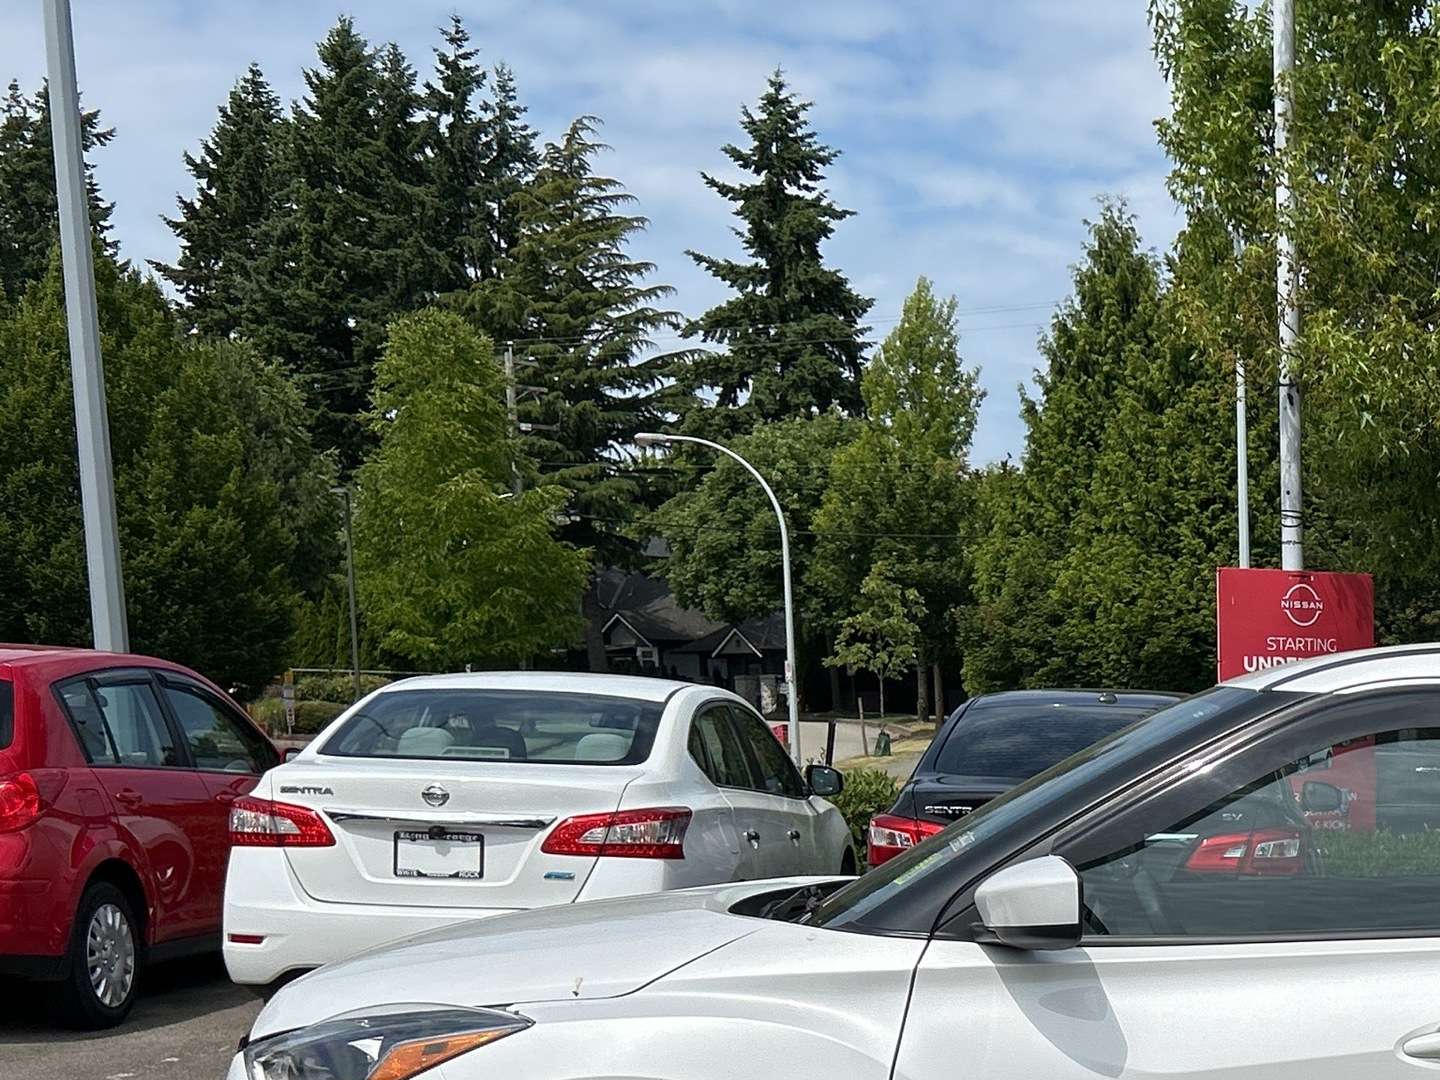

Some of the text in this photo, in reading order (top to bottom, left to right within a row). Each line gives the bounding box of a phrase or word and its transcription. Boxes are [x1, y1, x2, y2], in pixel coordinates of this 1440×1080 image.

[1280, 600, 1323, 610] NISSAN
[1266, 637, 1337, 653] STARTING
[1243, 655, 1303, 672] UND
[280, 786, 334, 796] SENTRA
[924, 805, 972, 815] SENTR
